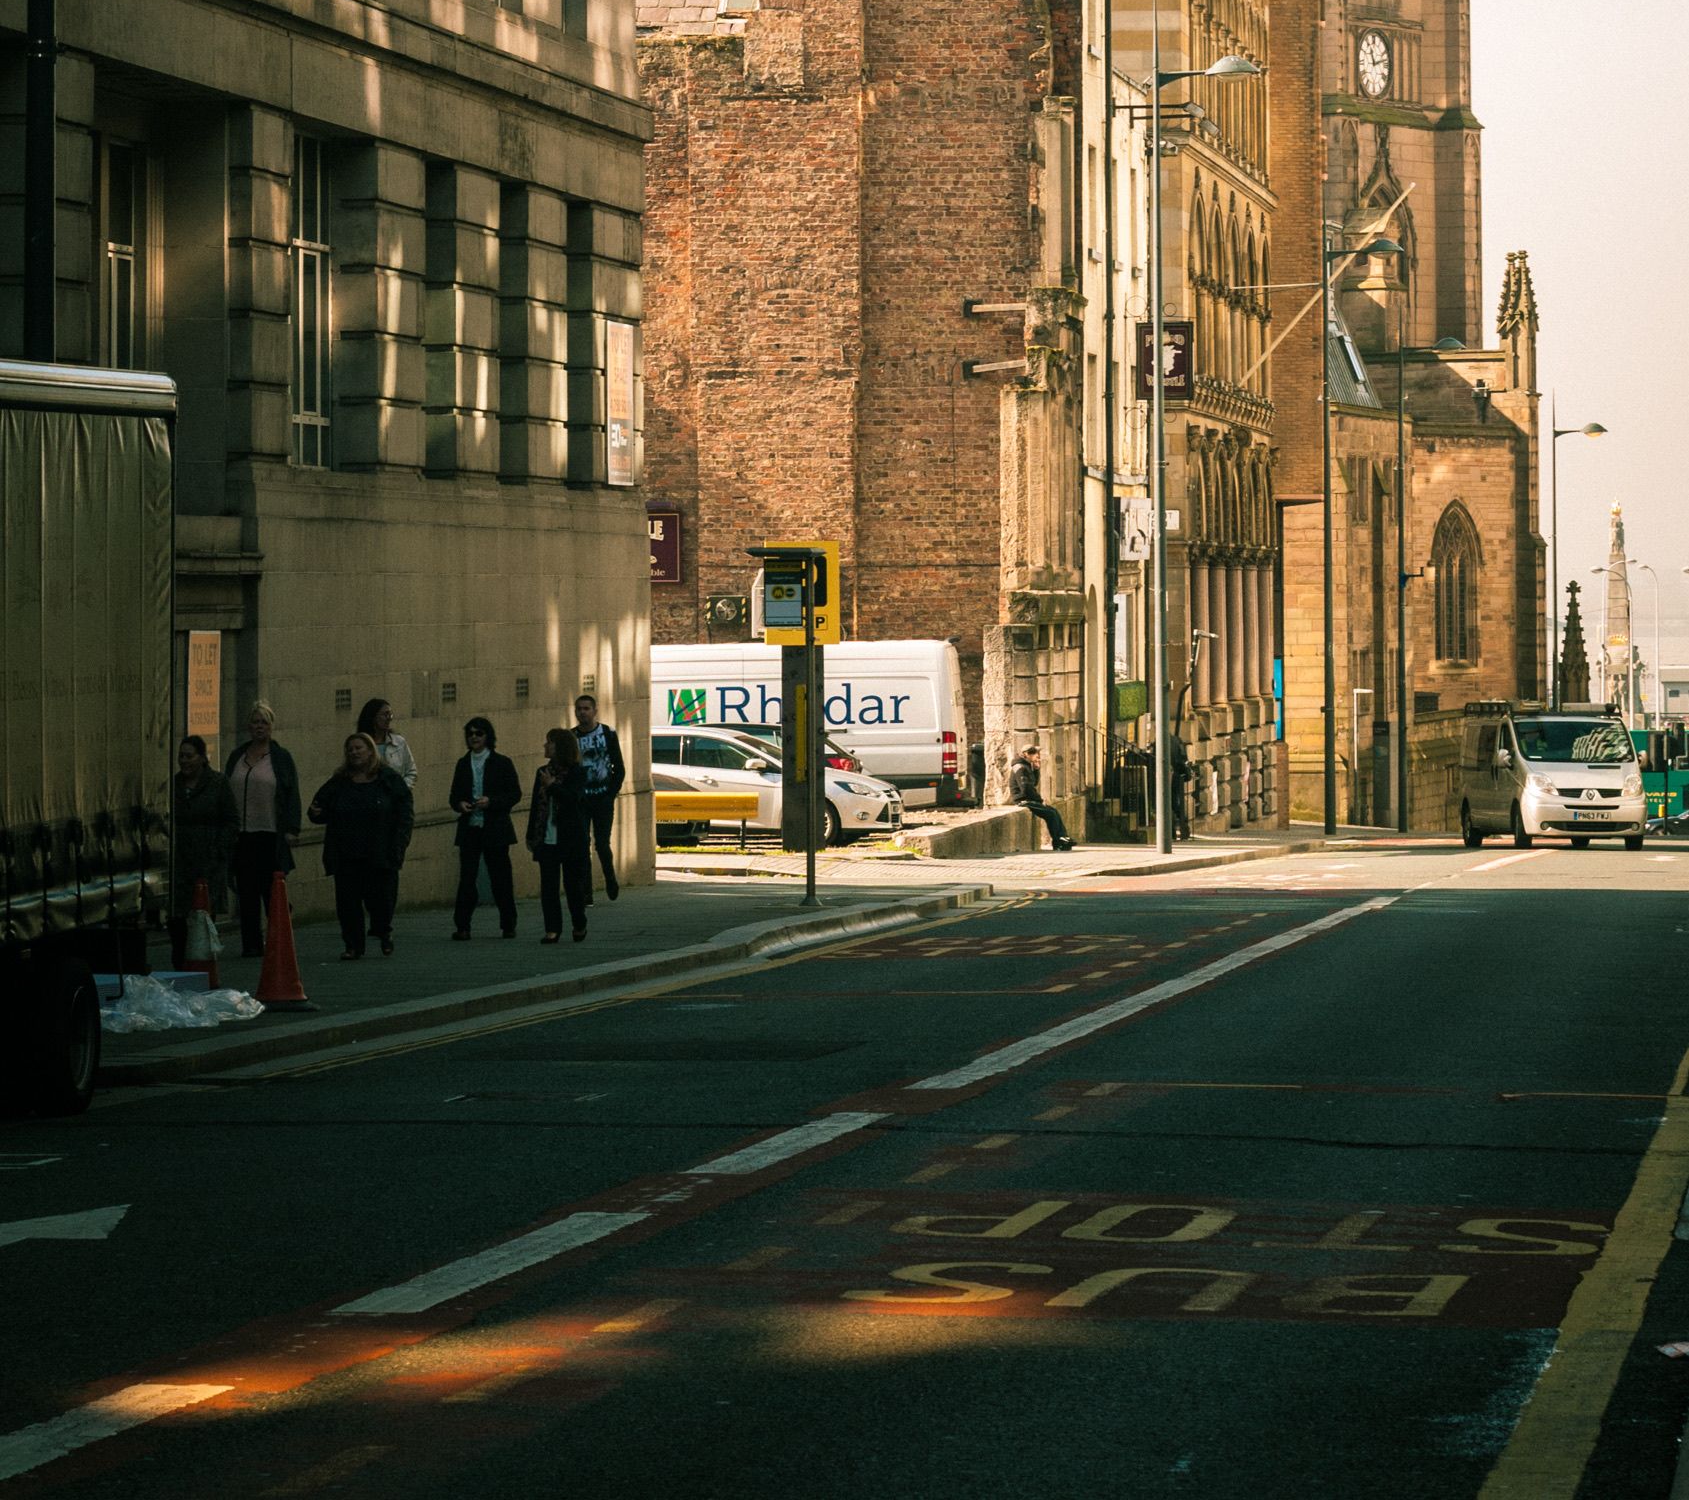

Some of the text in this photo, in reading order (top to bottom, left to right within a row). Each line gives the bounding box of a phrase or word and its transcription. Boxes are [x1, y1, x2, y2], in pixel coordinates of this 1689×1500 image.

[192, 643, 217, 666] TO LET
[715, 683, 910, 725] Rhdar
[889, 1200, 1611, 1255] STOP
[842, 1261, 1470, 1316] BUS
